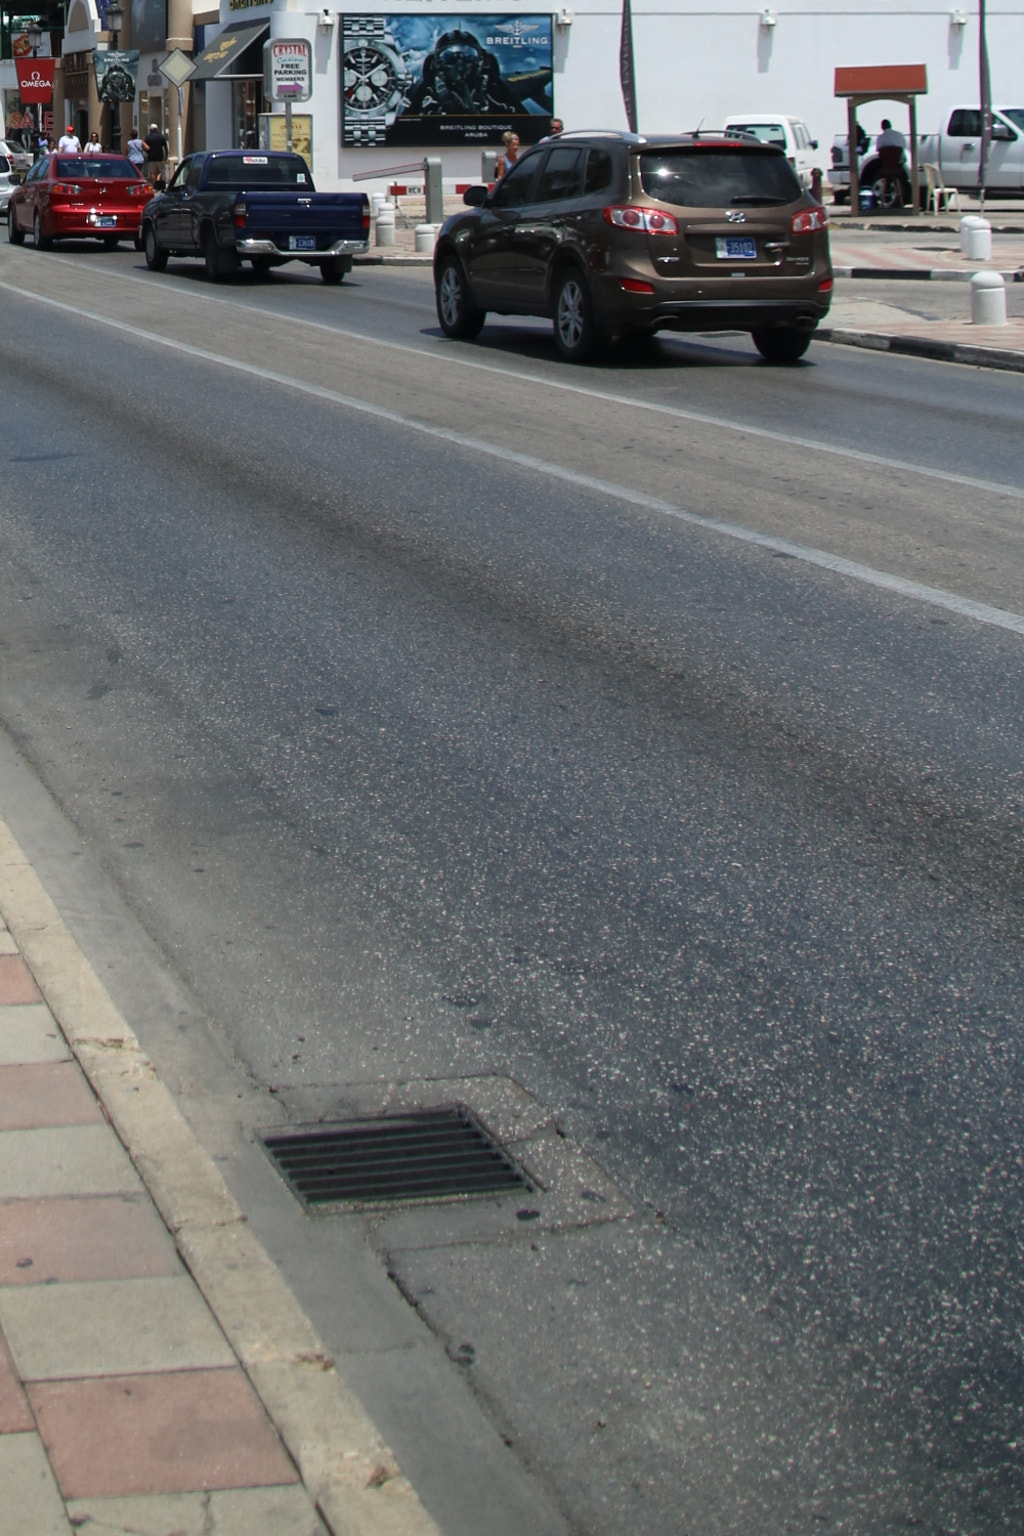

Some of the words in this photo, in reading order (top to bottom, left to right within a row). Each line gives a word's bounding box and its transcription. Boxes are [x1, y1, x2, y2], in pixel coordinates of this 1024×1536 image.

[486, 37, 548, 45] BREITLING
[273, 44, 307, 57] CRYSTAL
[21, 80, 52, 88] OMEGA
